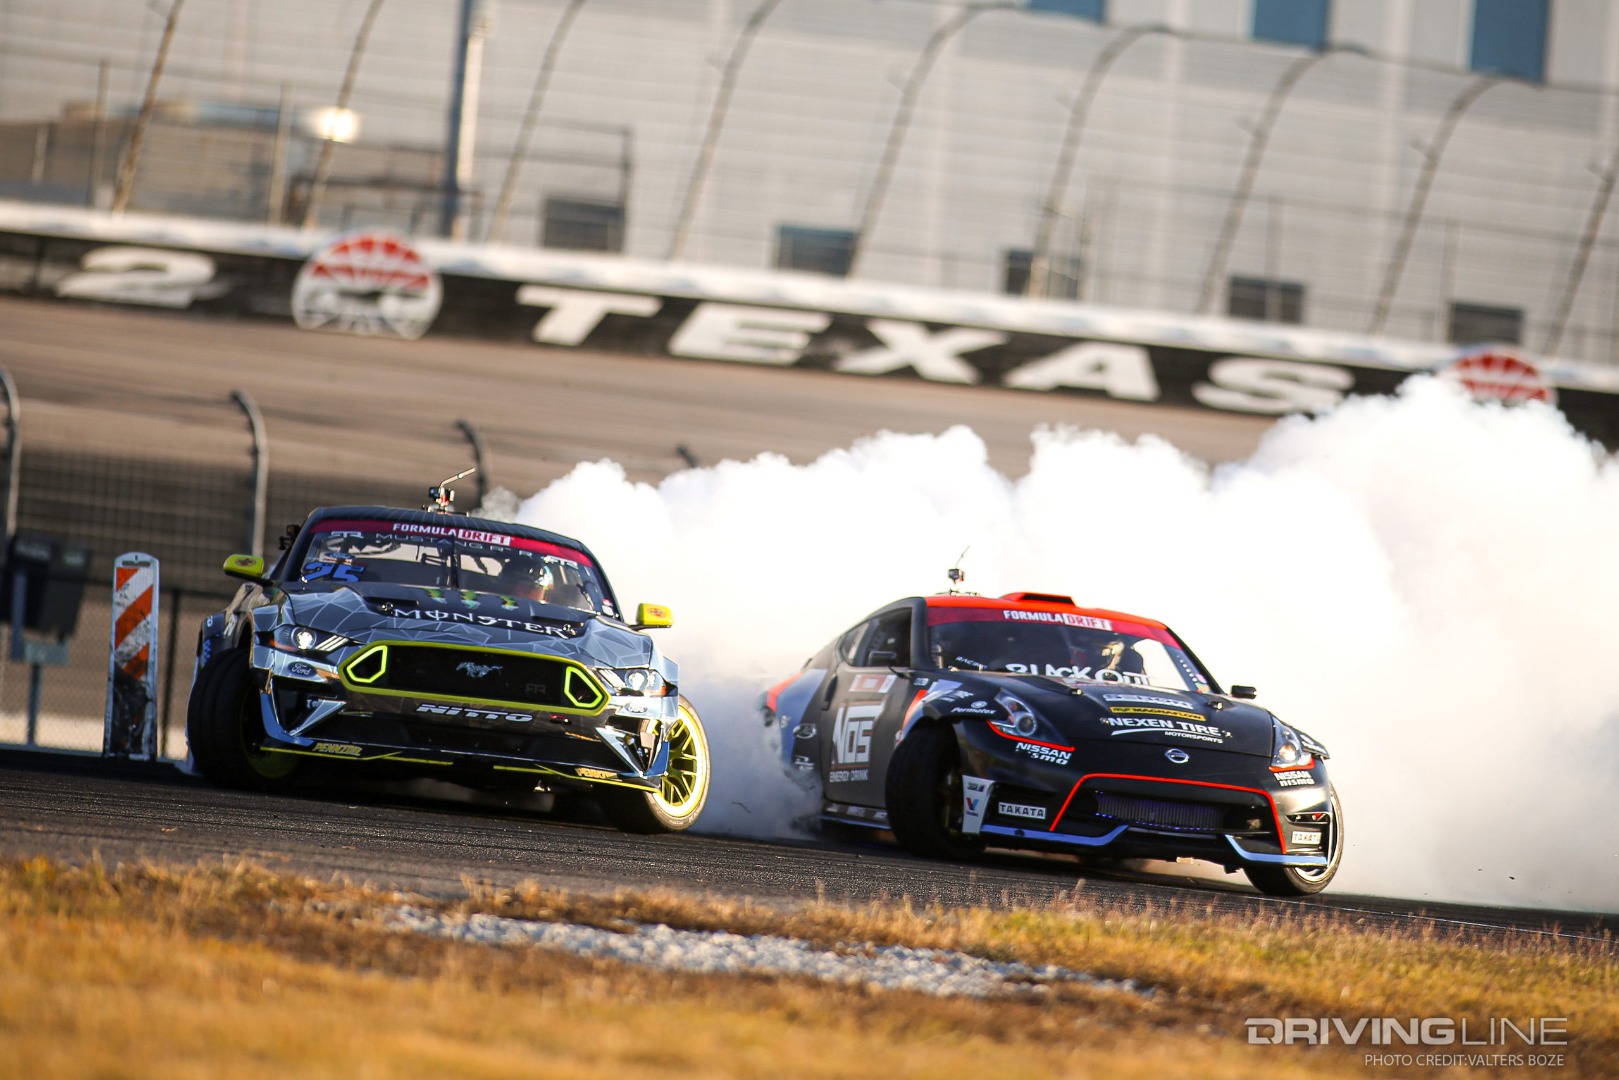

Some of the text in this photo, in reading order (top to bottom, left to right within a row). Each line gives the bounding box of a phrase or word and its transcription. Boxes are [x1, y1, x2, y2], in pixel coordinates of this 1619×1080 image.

[57, 246, 216, 308] 2
[515, 285, 1354, 414] TEXAS
[393, 523, 510, 546] FORMULA DRIFT
[394, 608, 570, 640] MONSTER
[1003, 610, 1111, 630] FORMULA DRIFT
[292, 663, 312, 676] Ford
[415, 703, 533, 723] NITTO
[832, 702, 885, 764] NOS
[1108, 717, 1221, 736] NEXEN TIRE
[1164, 730, 1223, 744] MOTORSPORTS
[1016, 742, 1072, 760] NISSAN
[1274, 771, 1312, 781] NISSAN
[1000, 804, 1045, 817] TAKATA
